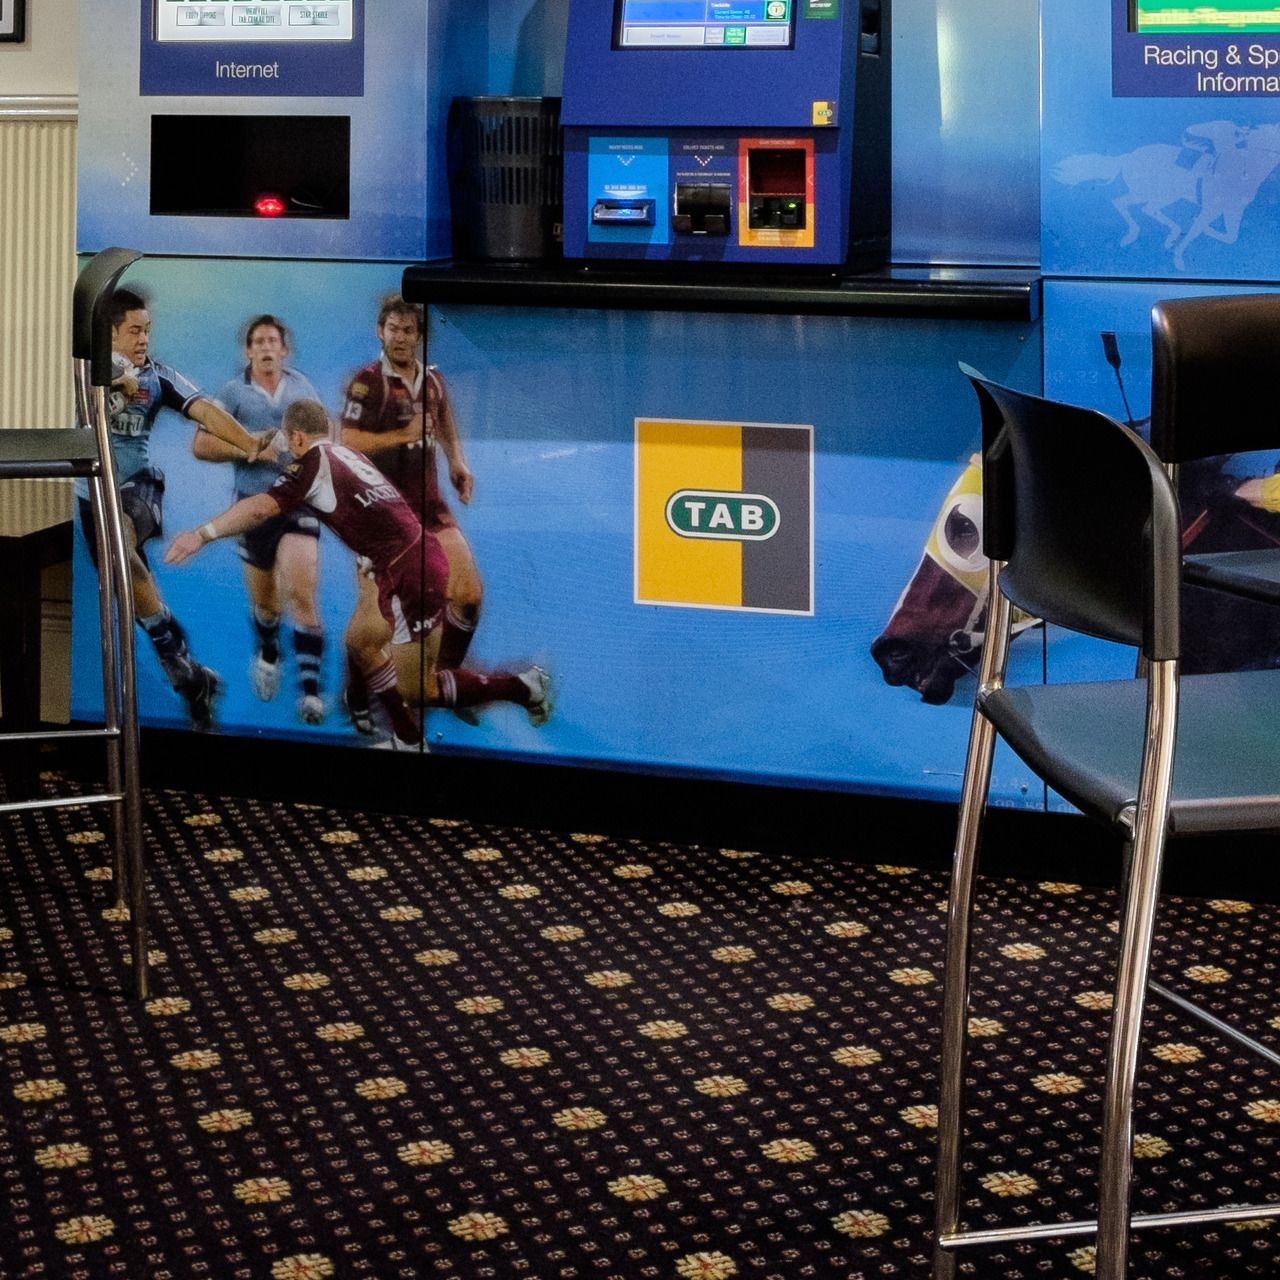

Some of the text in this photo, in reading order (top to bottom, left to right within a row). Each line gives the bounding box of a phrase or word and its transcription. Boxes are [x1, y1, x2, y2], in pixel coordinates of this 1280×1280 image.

[1144, 45, 1218, 69] Racing
[1226, 45, 1241, 64] &
[216, 61, 280, 78] Internet
[345, 401, 363, 420] 13
[684, 501, 764, 530] TAB
